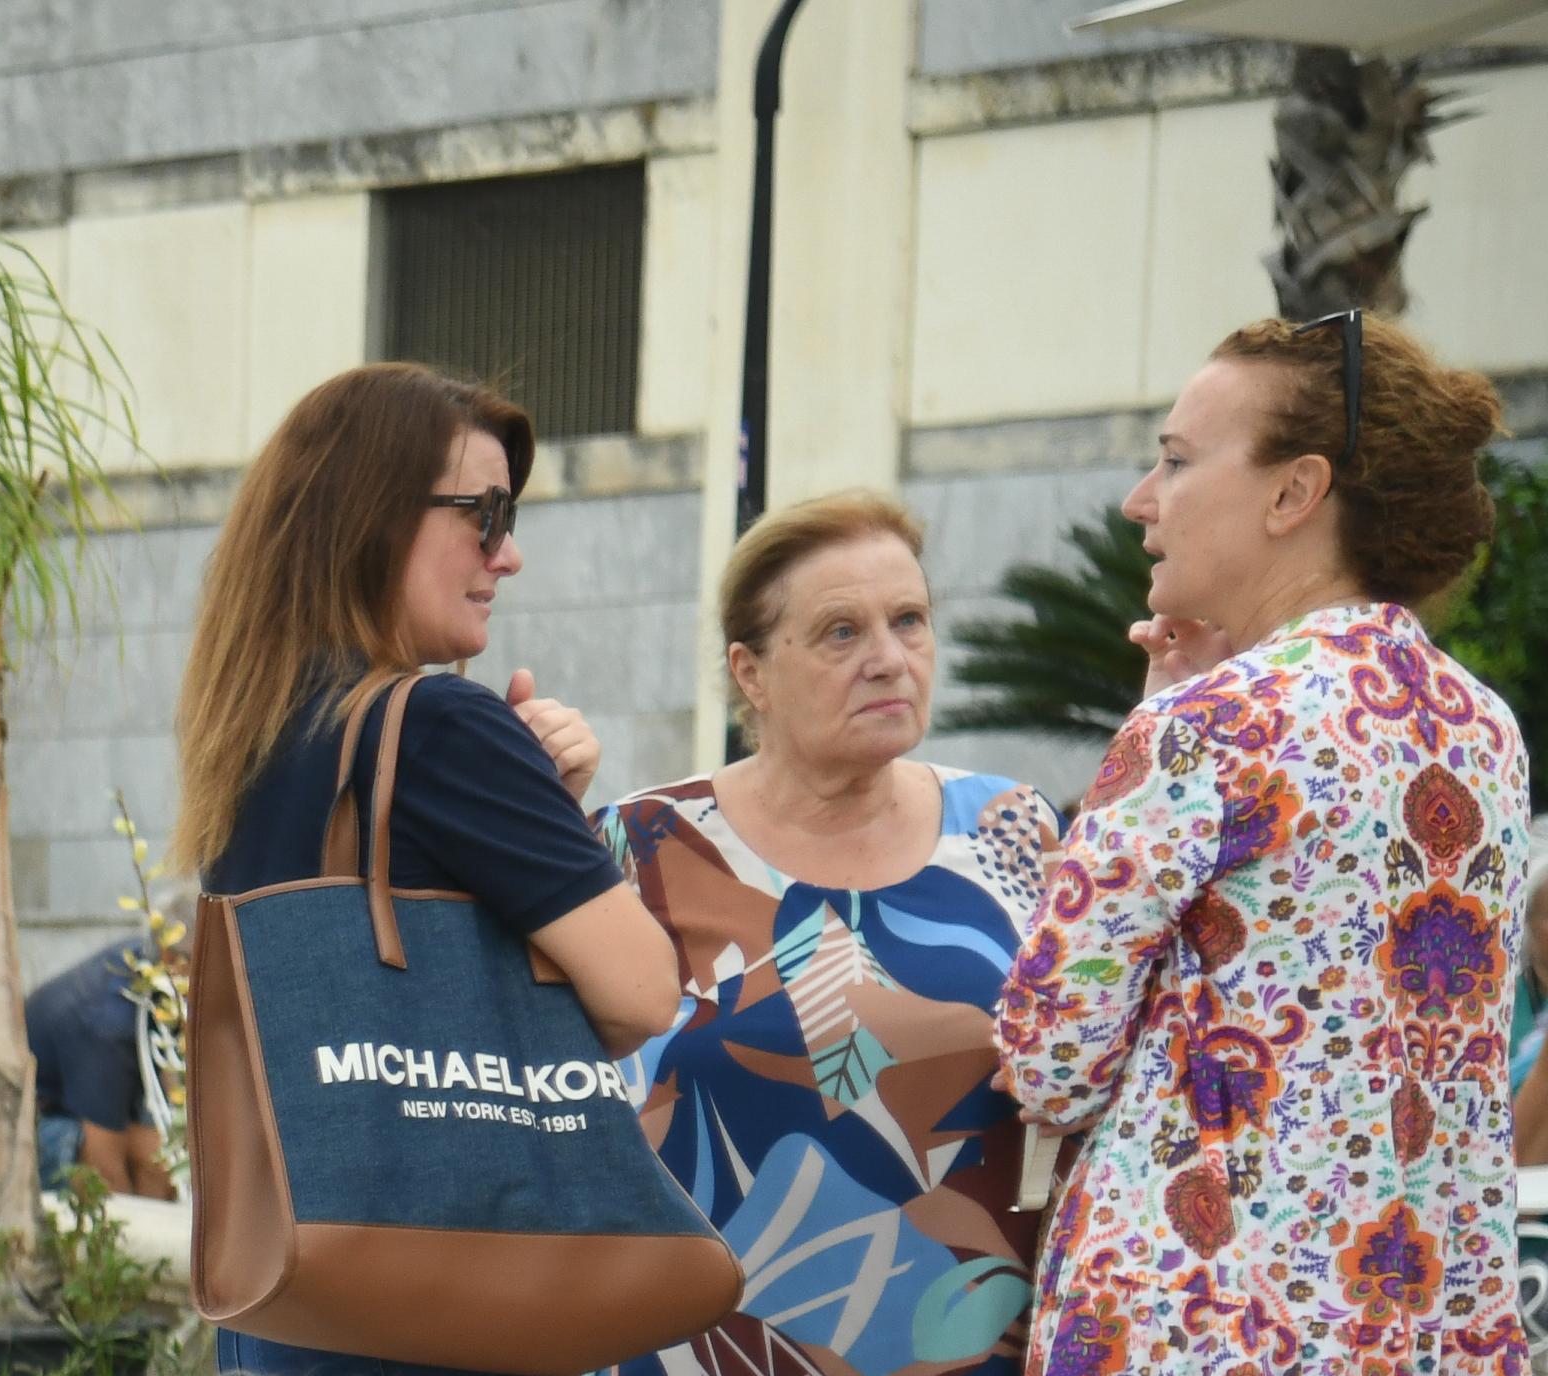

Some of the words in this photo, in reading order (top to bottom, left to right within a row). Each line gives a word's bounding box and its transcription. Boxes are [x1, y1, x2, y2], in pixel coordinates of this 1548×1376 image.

[402, 1100, 447, 1119] NEW
[452, 1101, 506, 1122] YORK
[541, 1113, 588, 1133] 1981
